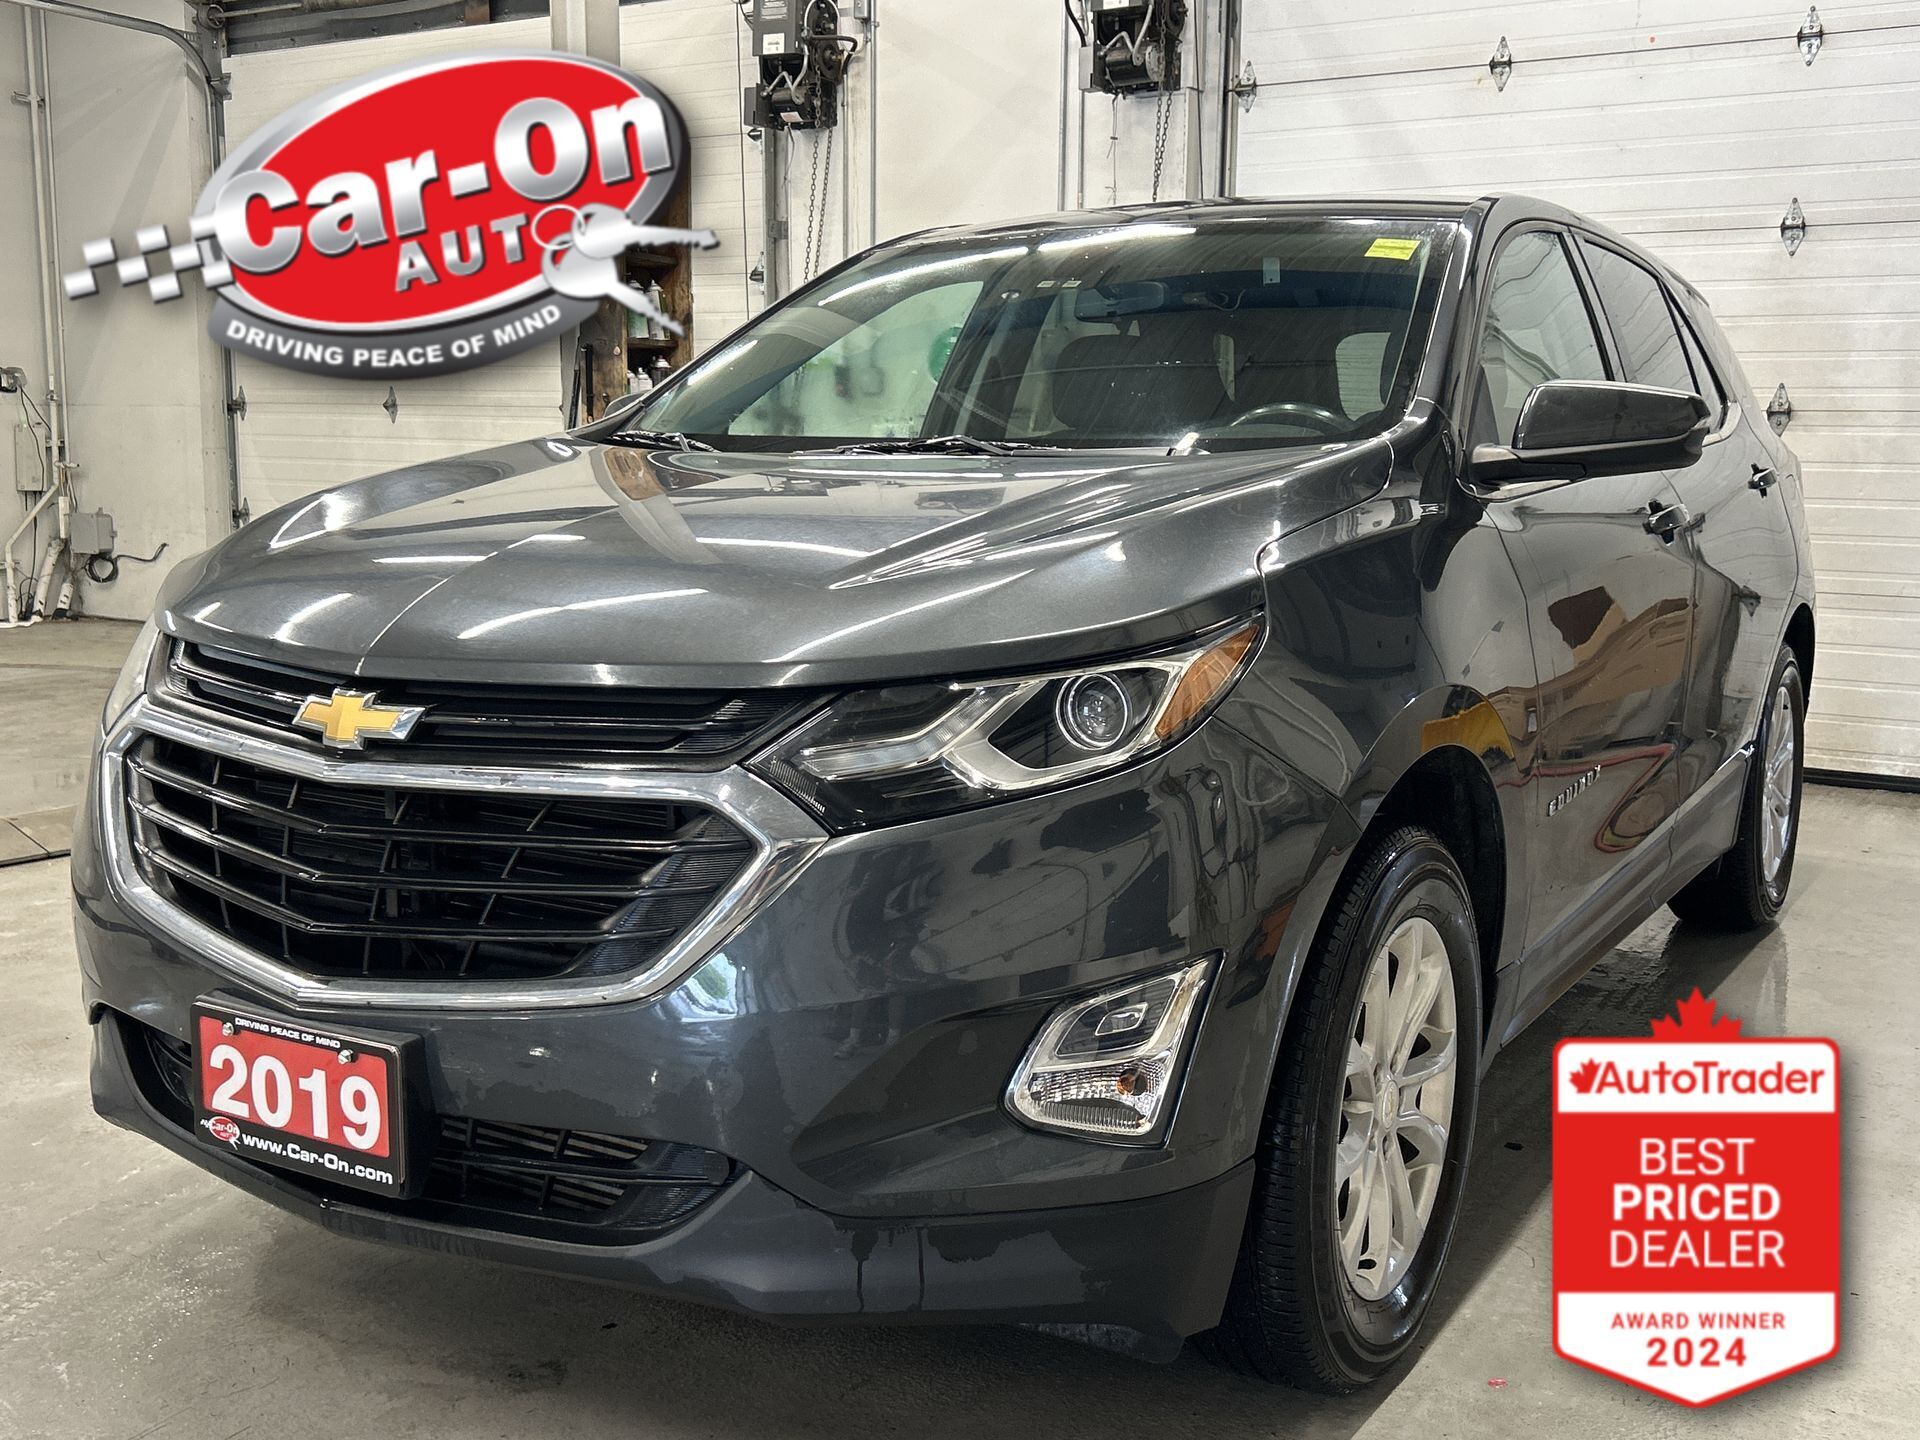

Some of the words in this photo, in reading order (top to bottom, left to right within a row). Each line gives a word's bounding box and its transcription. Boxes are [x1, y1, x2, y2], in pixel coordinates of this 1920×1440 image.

[235, 1017, 269, 1032] DRIVING
[271, 1026, 300, 1040] PEACE
[301, 1033, 314, 1042] OF
[316, 1036, 341, 1048] MIND
[209, 1044, 381, 1150] 2019
[242, 1132, 393, 1185] www.Car-On.com
